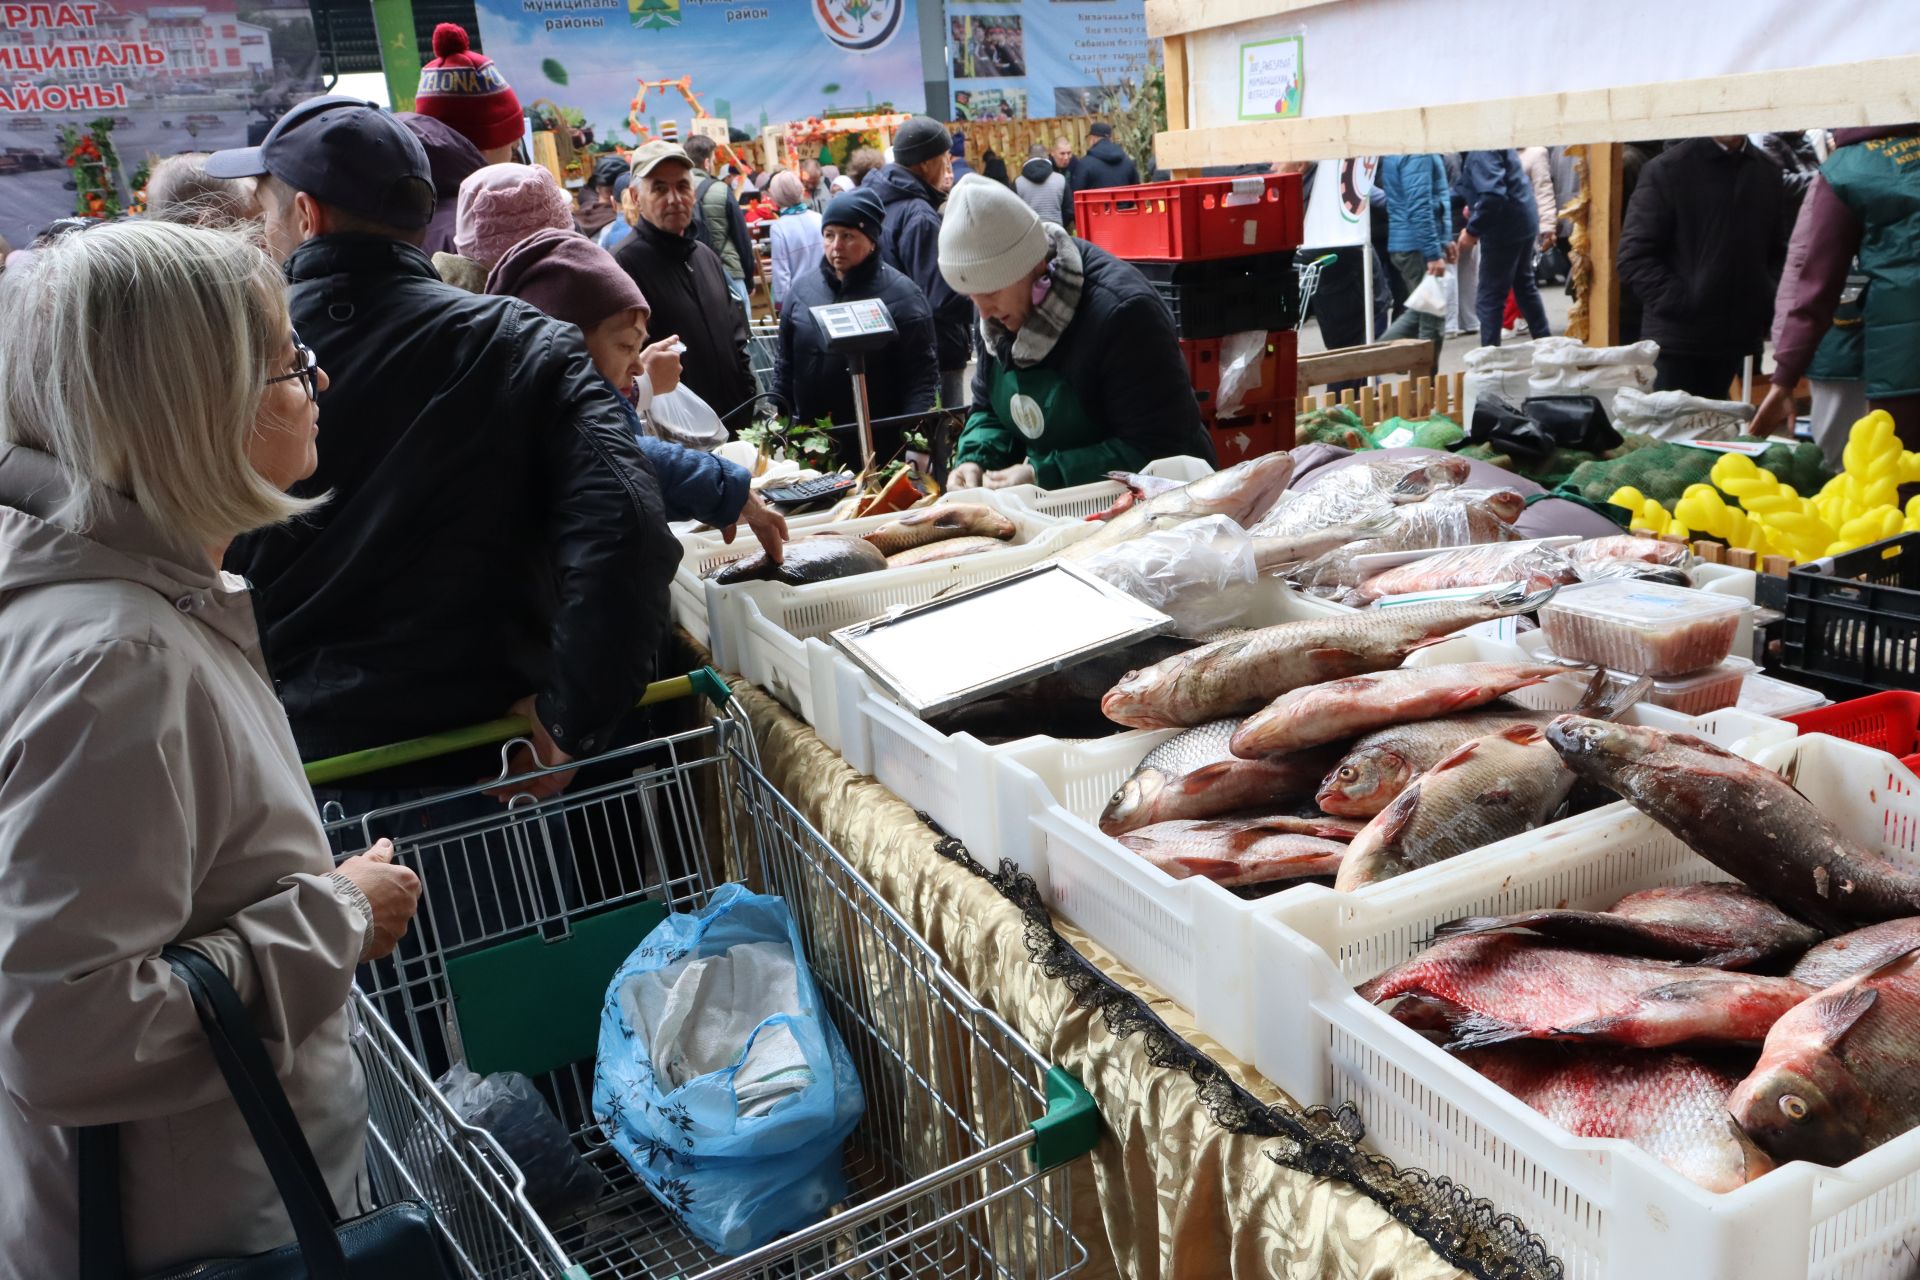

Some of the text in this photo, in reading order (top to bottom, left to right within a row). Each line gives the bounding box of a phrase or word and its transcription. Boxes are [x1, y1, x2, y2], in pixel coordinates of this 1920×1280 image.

[522, 0, 619, 12] муниципаль
[727, 7, 768, 22] район
[545, 16, 604, 32] районы
